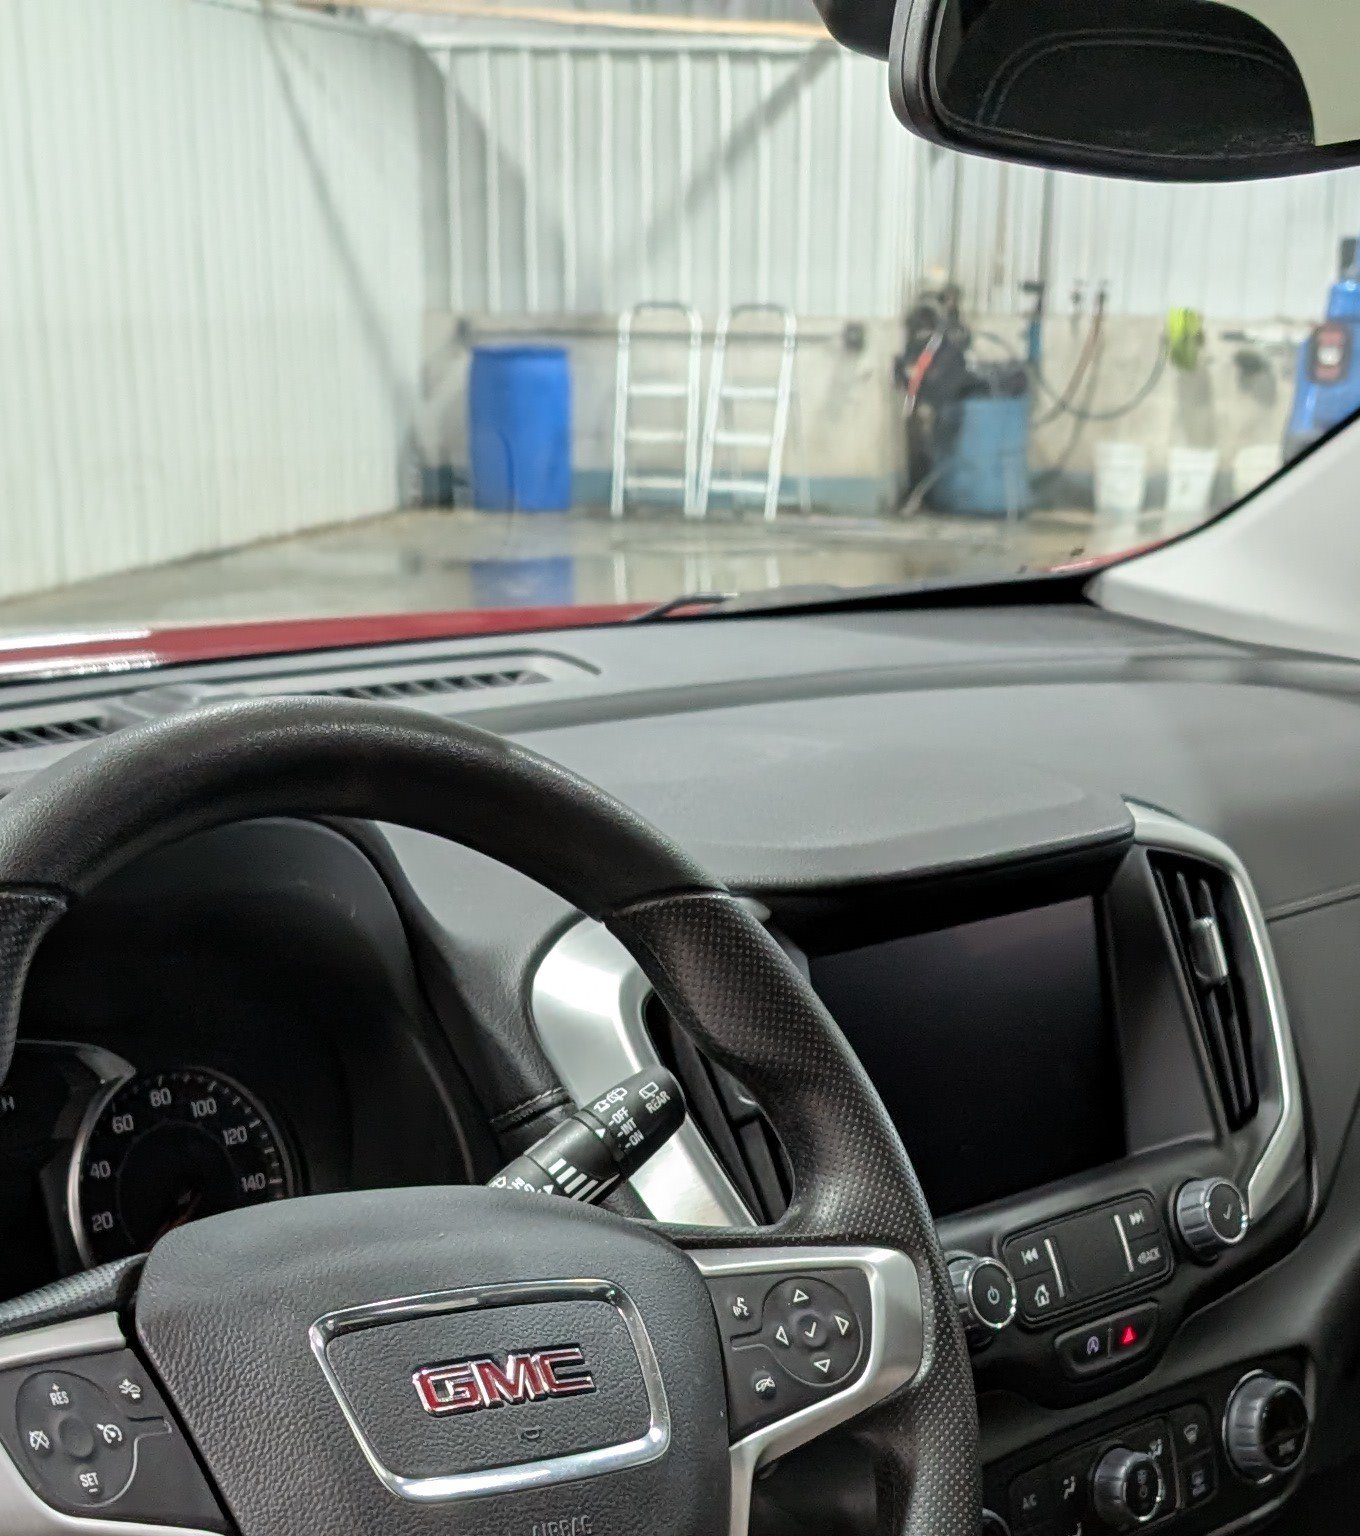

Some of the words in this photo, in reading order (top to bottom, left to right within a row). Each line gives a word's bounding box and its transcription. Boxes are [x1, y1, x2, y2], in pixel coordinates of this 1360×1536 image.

[149, 1087, 172, 1107] 80
[645, 1090, 671, 1114] REAR
[190, 1097, 217, 1118] 100
[112, 1114, 134, 1133] 60
[222, 1126, 248, 1146] 120
[90, 1160, 111, 1179] 40
[241, 1172, 266, 1193] 140
[92, 1211, 114, 1232] 20
[411, 1345, 595, 1414] GMC
[49, 1391, 70, 1406] RES
[79, 1472, 99, 1488] SET
